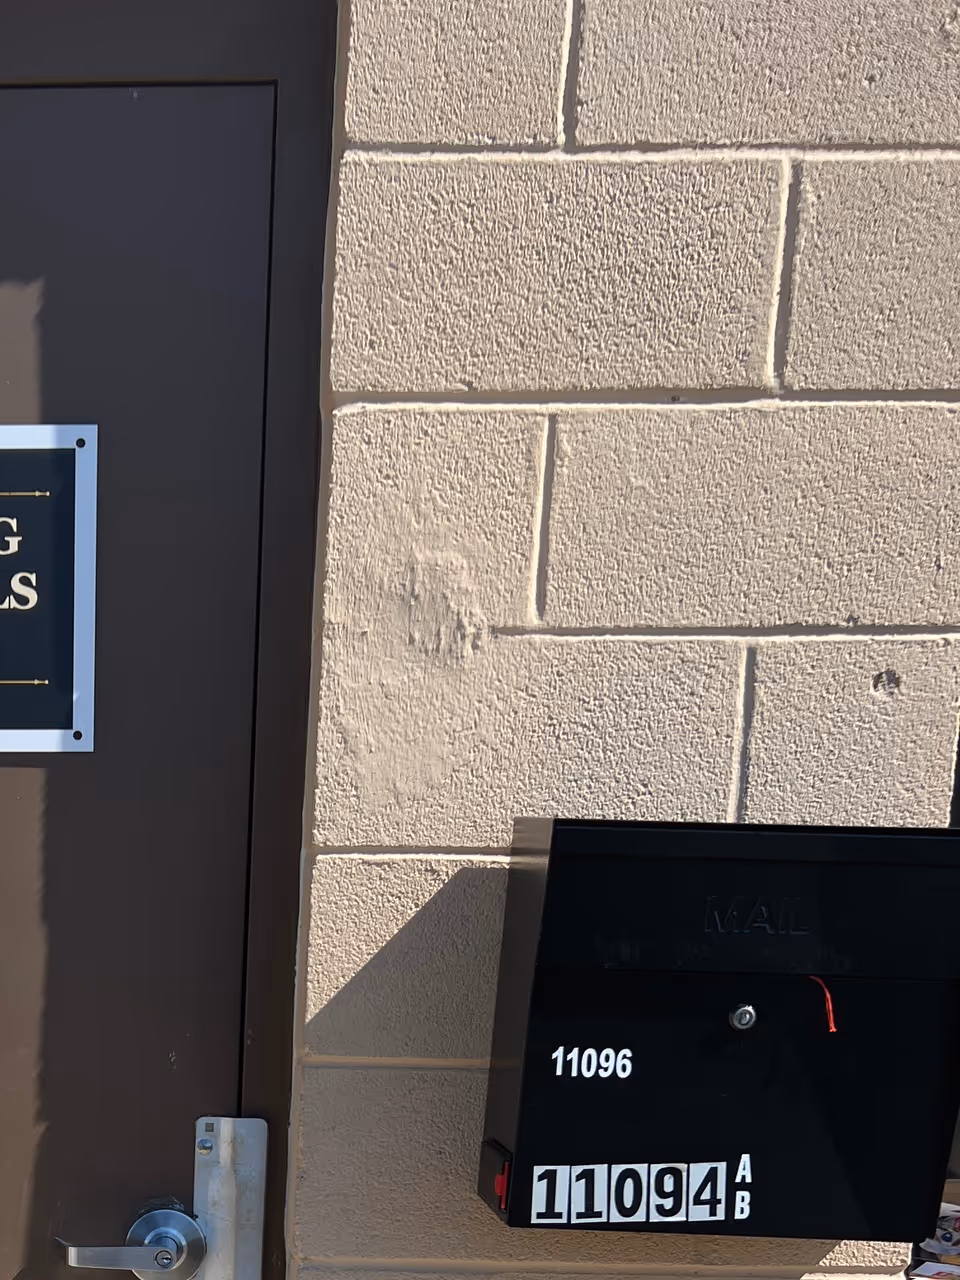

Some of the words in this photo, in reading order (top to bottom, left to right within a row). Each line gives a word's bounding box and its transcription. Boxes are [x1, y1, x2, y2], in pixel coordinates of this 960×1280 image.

[704, 896, 812, 935] MAIL
[551, 1046, 633, 1078] 11096
[735, 1154, 752, 1183] A
[536, 1167, 722, 1219] 11094
[734, 1191, 751, 1220] B
